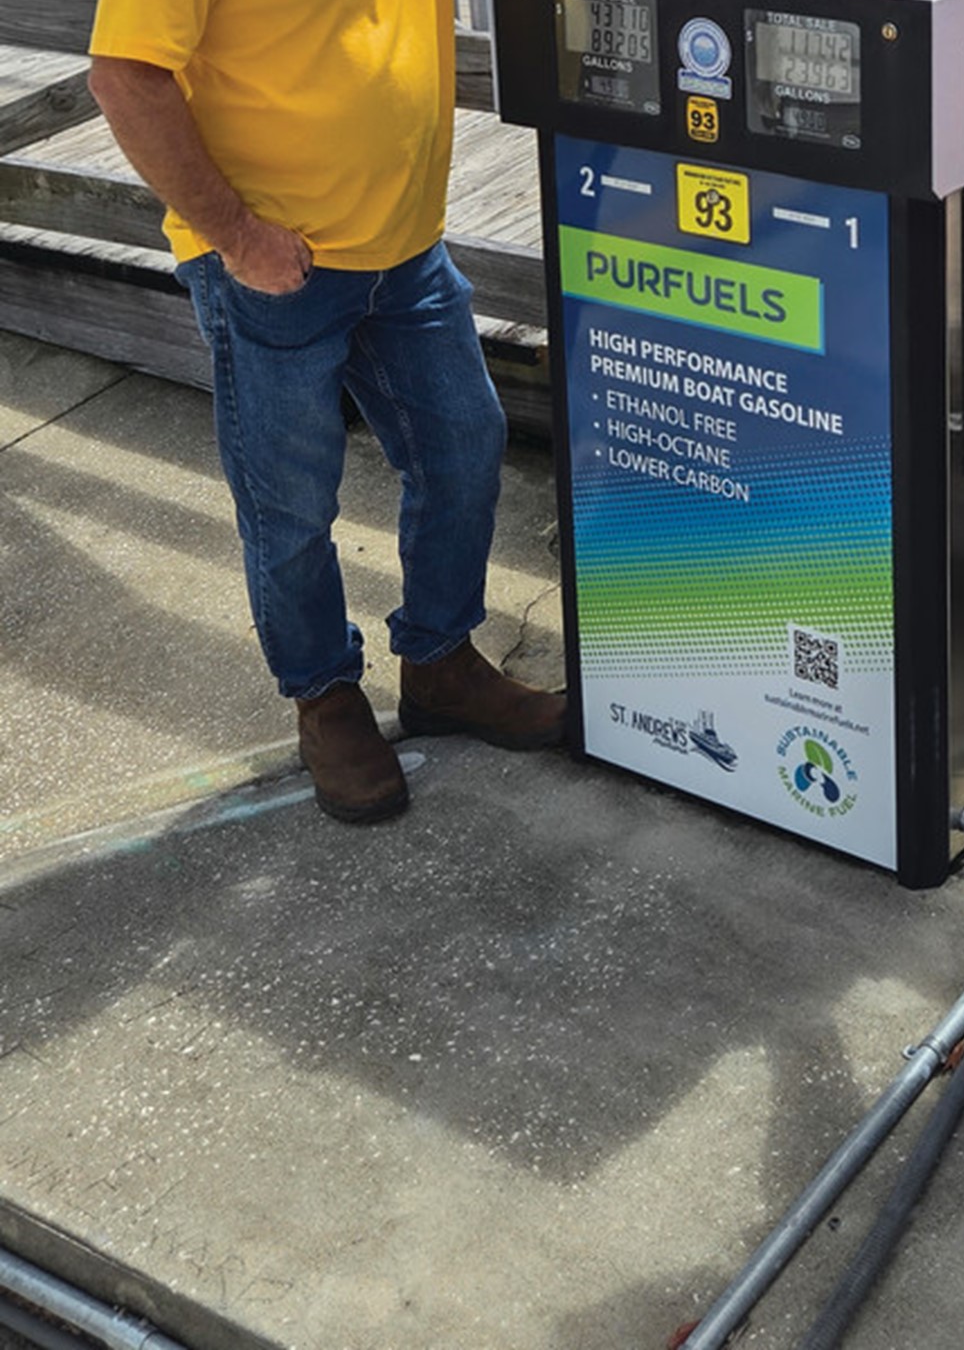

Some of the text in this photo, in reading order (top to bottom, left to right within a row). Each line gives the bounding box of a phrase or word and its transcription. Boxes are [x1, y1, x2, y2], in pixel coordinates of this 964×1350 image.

[767, 11, 836, 31] TOTAL SALE
[582, 54, 633, 73] GALLONS
[774, 85, 830, 104] GALLONS
[690, 109, 716, 131] 93
[579, 166, 596, 197] 2
[695, 190, 732, 232] 93
[845, 217, 858, 249] 1
[586, 251, 788, 323] PURFUELS
[589, 328, 788, 394] HIGH PERFORMANCE
[590, 354, 844, 436] PREMIUM BOAT GASOLINE
[606, 390, 737, 442] ETHANOL FREE
[607, 418, 731, 469] HIGH-OCTANE
[608, 447, 750, 503] LOWER CARBON
[789, 688, 811, 703] Learn
[812, 696, 832, 709] more
[610, 702, 628, 727] ST.
[632, 710, 688, 748] ANDREWS
[776, 726, 858, 781] SUSTAINABLE
[778, 765, 858, 818] MARINE FUEL
